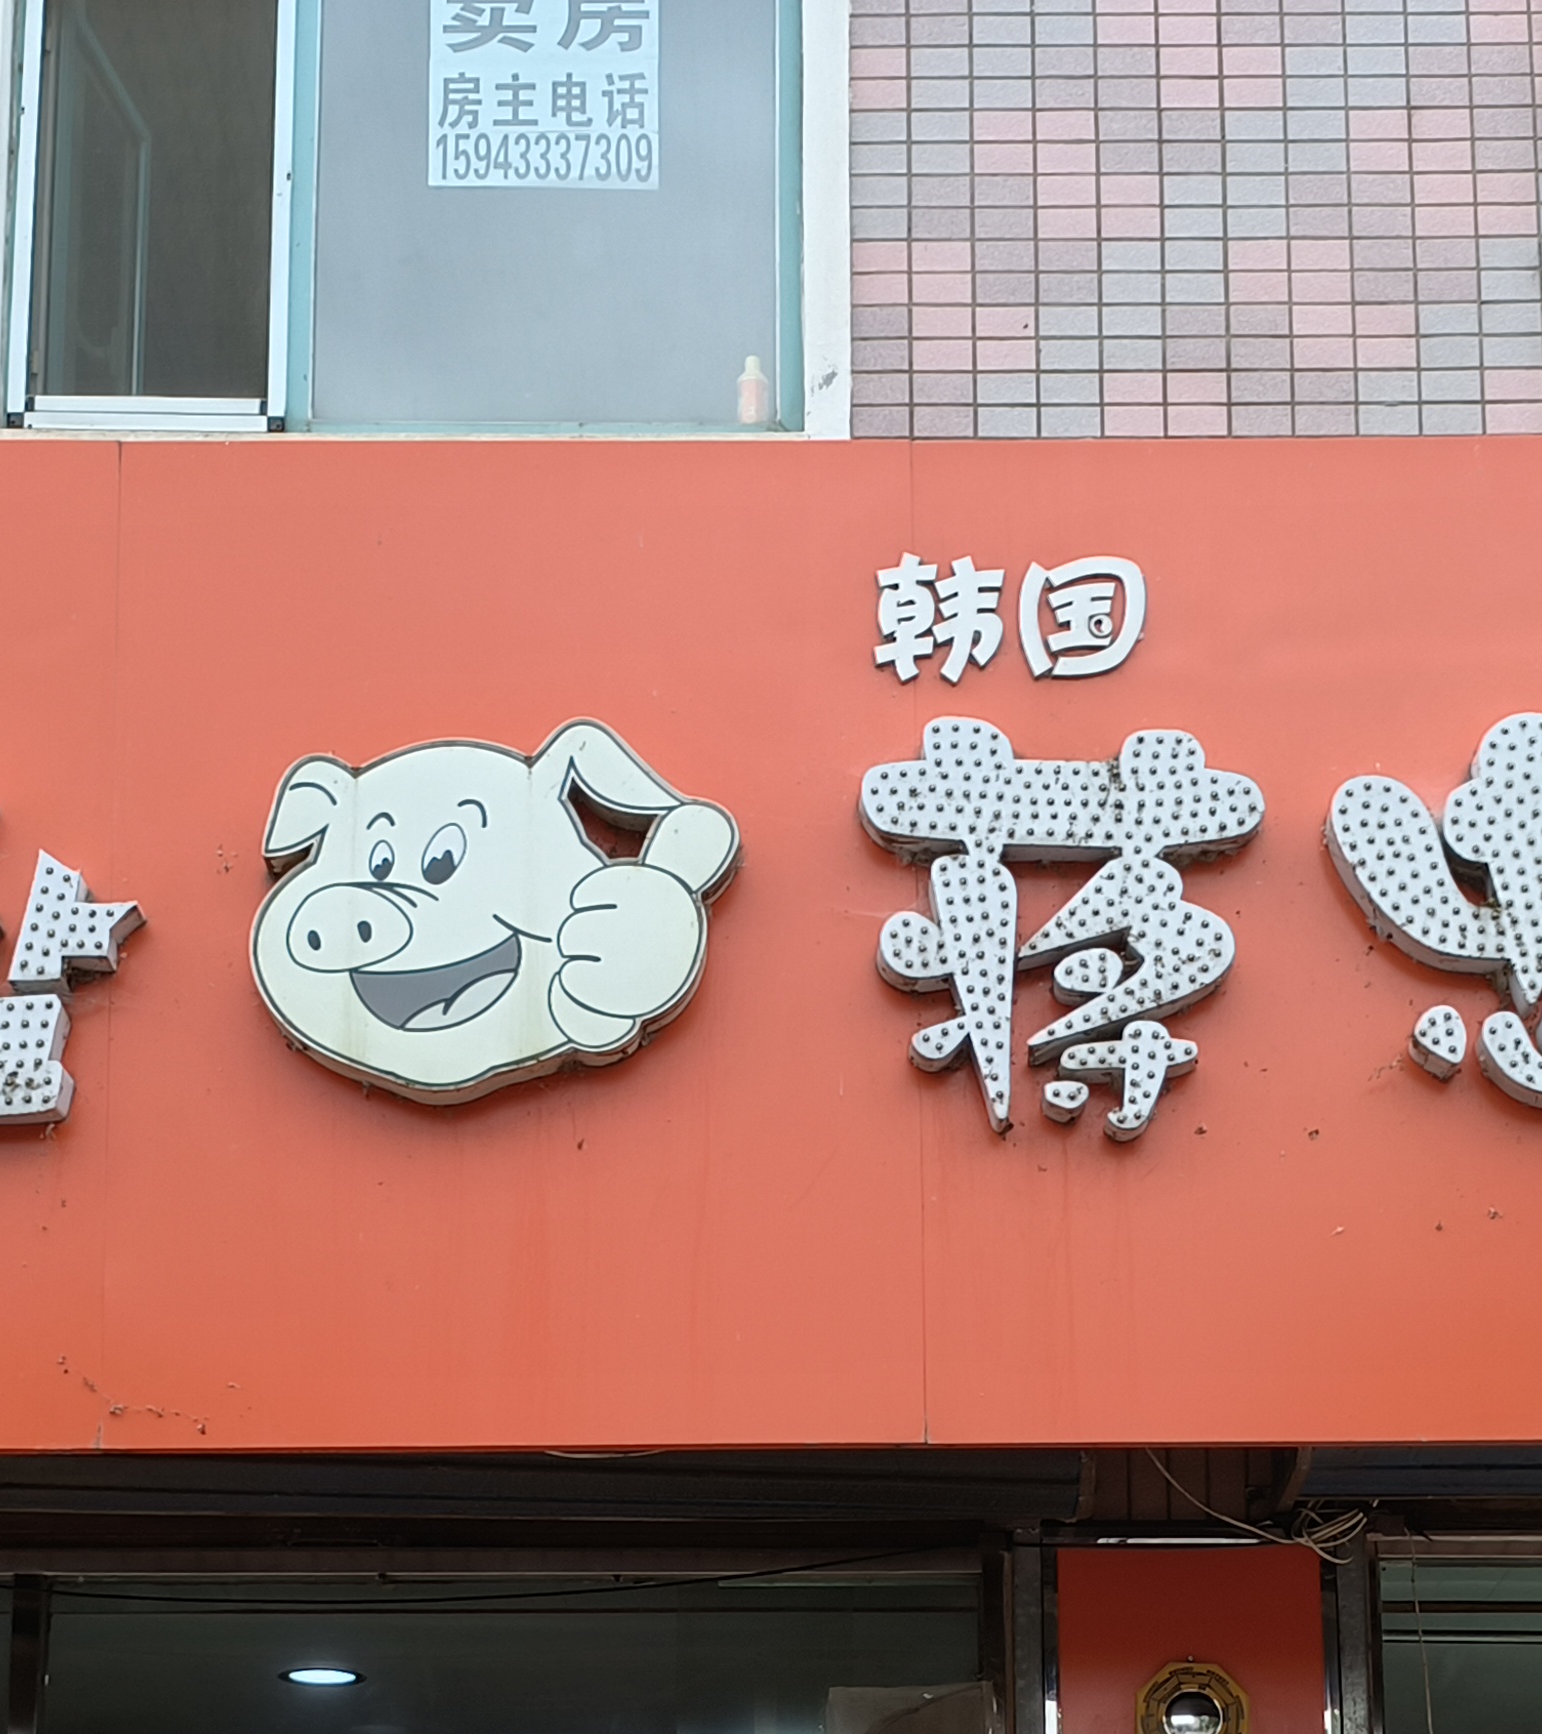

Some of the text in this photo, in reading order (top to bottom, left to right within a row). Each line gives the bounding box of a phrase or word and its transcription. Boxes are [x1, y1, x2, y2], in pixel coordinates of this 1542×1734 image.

[437, 72, 649, 129] 房主电话
[435, 132, 653, 182] 15943337309
[872, 551, 1147, 684] 韩国
